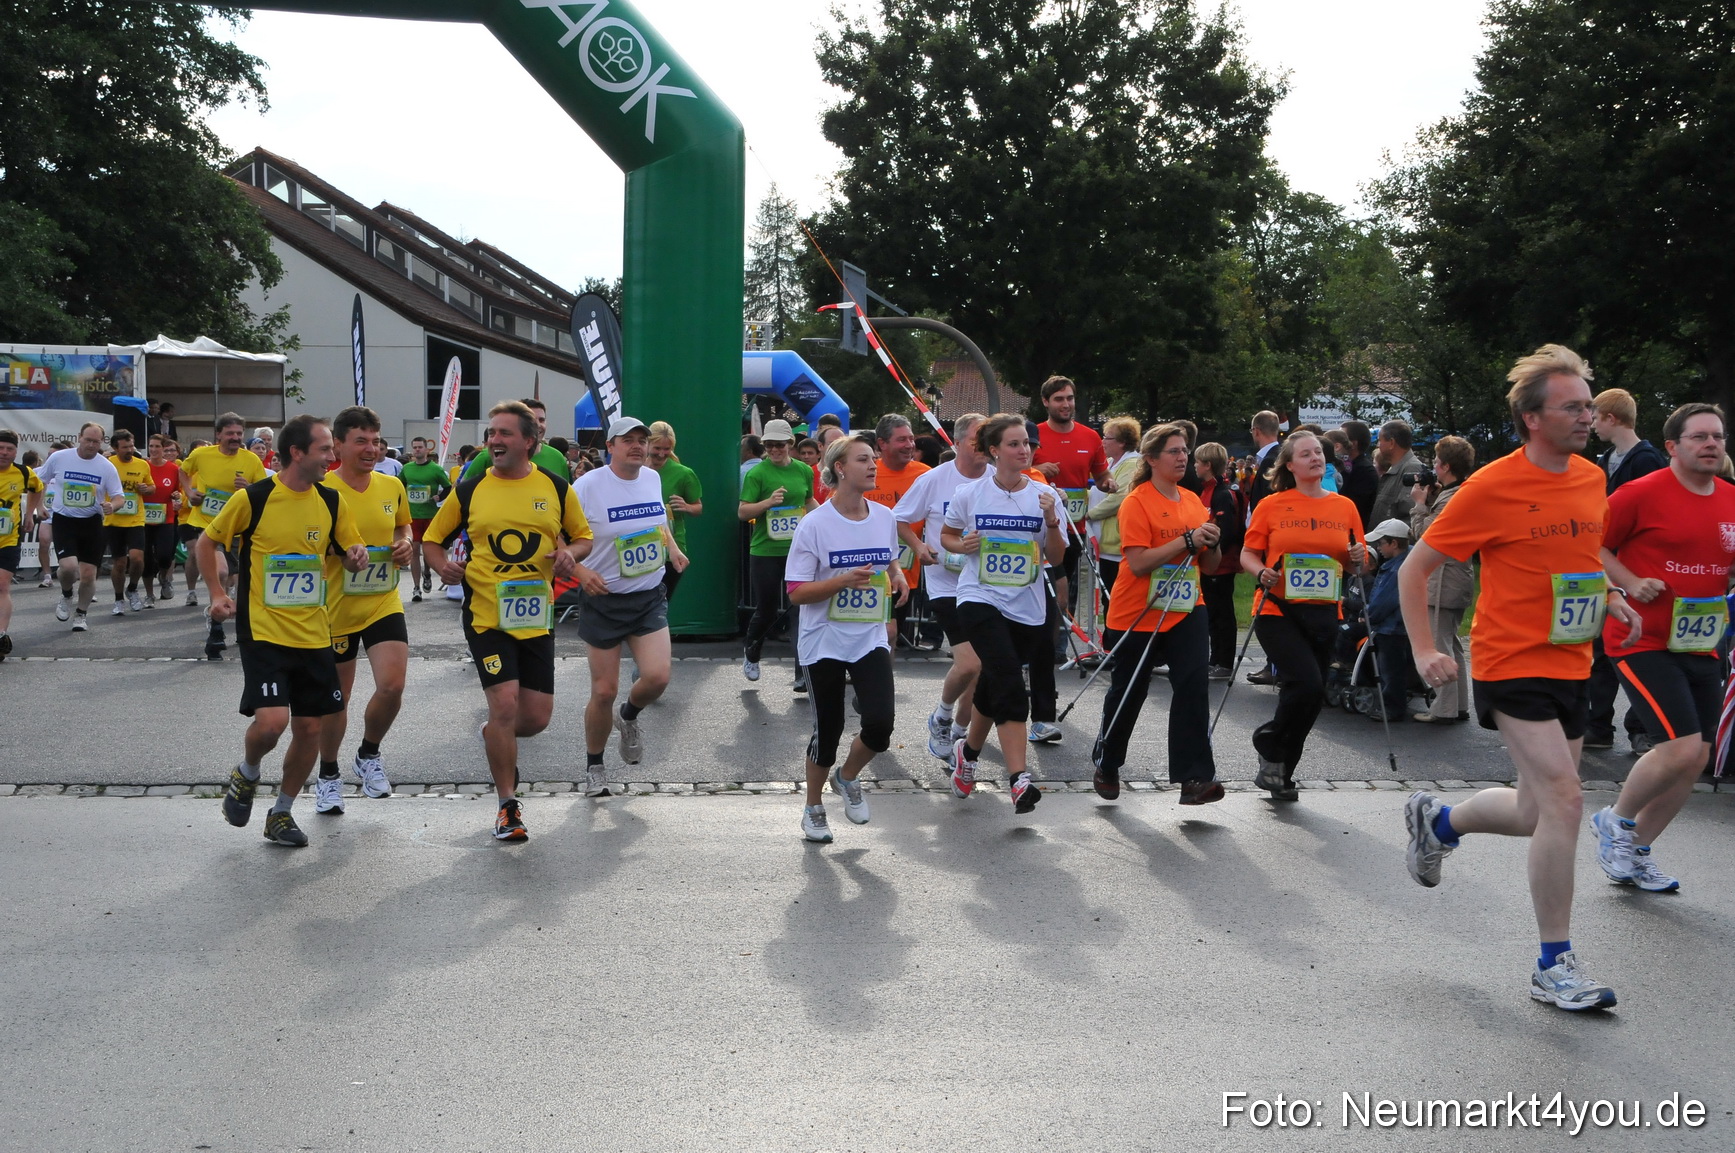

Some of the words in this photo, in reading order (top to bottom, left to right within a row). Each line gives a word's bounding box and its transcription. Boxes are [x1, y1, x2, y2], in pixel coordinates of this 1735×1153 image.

[519, 0, 698, 144] AOK
[0, 367, 49, 384] TLA
[57, 377, 120, 394] Logistics
[69, 473, 99, 483] STAEDTLER
[66, 490, 88, 502] 901
[409, 491, 425, 499] 831
[868, 493, 893, 502] EURO
[204, 497, 227, 510] 127
[384, 505, 393, 513] FC
[534, 502, 546, 510] FC
[146, 510, 163, 519] 297
[618, 505, 662, 518] STAEDTLER
[771, 517, 798, 532] 835
[984, 518, 1038, 529] STAEDTLER
[1280, 520, 1309, 529] EURO
[307, 531, 319, 541] FC
[1530, 523, 1569, 539] EURO
[623, 543, 658, 568] 903
[841, 552, 891, 564] STAEDTLER
[985, 553, 1027, 575] 882
[270, 573, 315, 594] 773
[1289, 569, 1330, 588] 623
[1156, 580, 1192, 600] 583
[836, 587, 878, 609] 883
[503, 597, 541, 618] 768
[1559, 595, 1598, 627] 571
[1676, 615, 1717, 639] 943
[335, 641, 348, 650] FC
[486, 660, 500, 671] FC
[261, 682, 278, 697] 11
